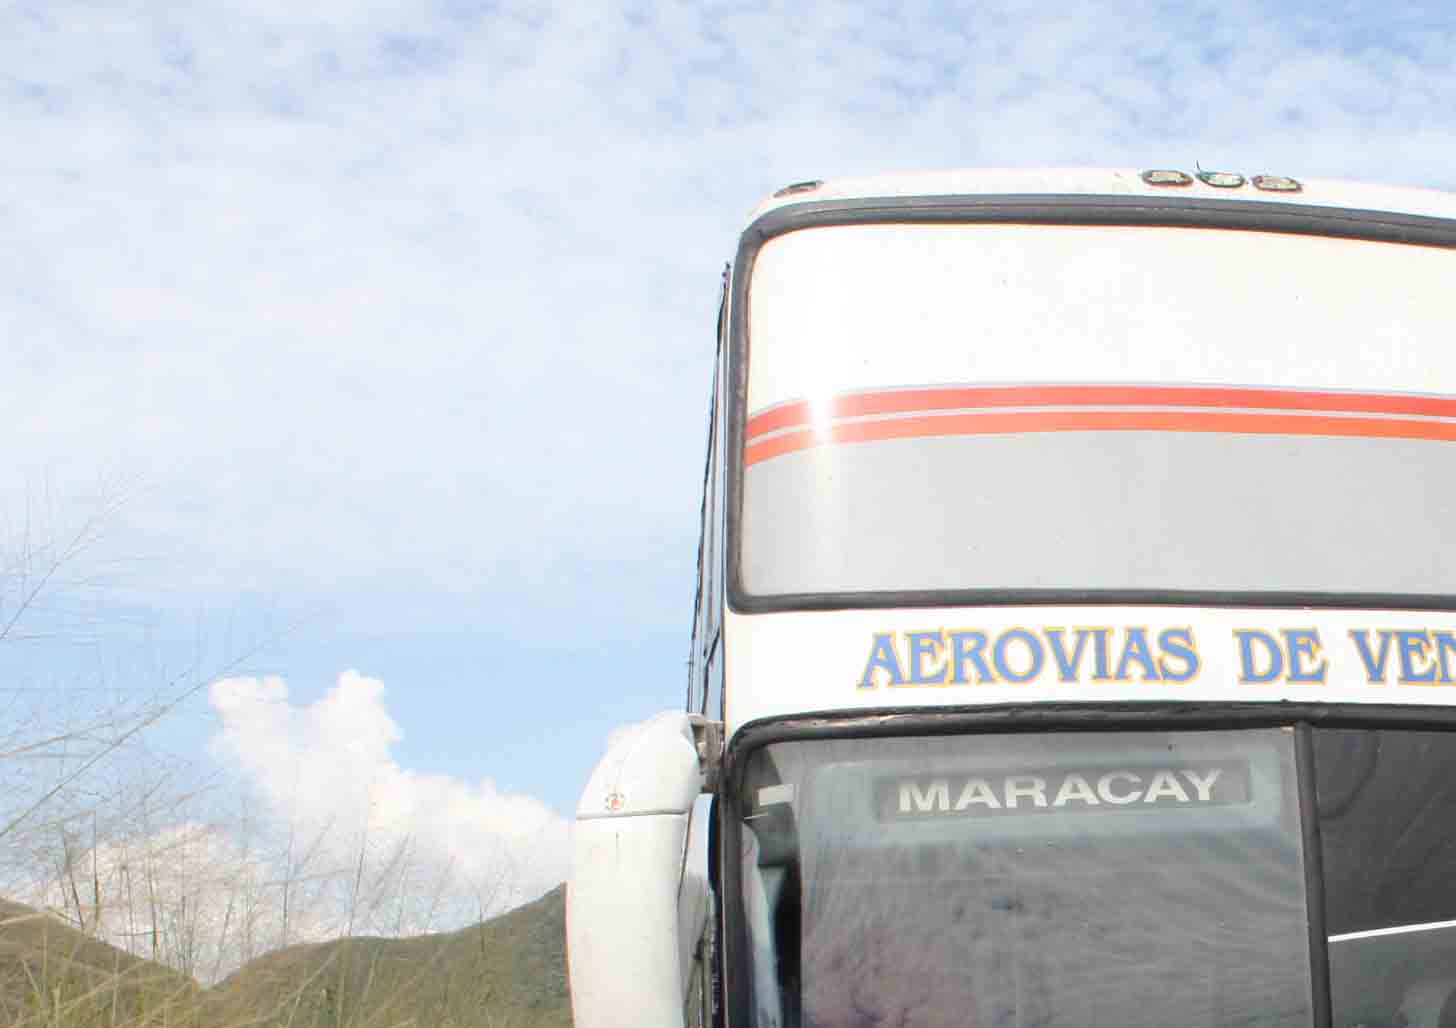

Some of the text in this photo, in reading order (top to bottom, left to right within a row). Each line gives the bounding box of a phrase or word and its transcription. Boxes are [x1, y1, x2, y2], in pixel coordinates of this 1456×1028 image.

[857, 625, 1201, 690] AEROVIAS
[1232, 627, 1328, 684] DE
[898, 768, 1223, 813] MARACAY
